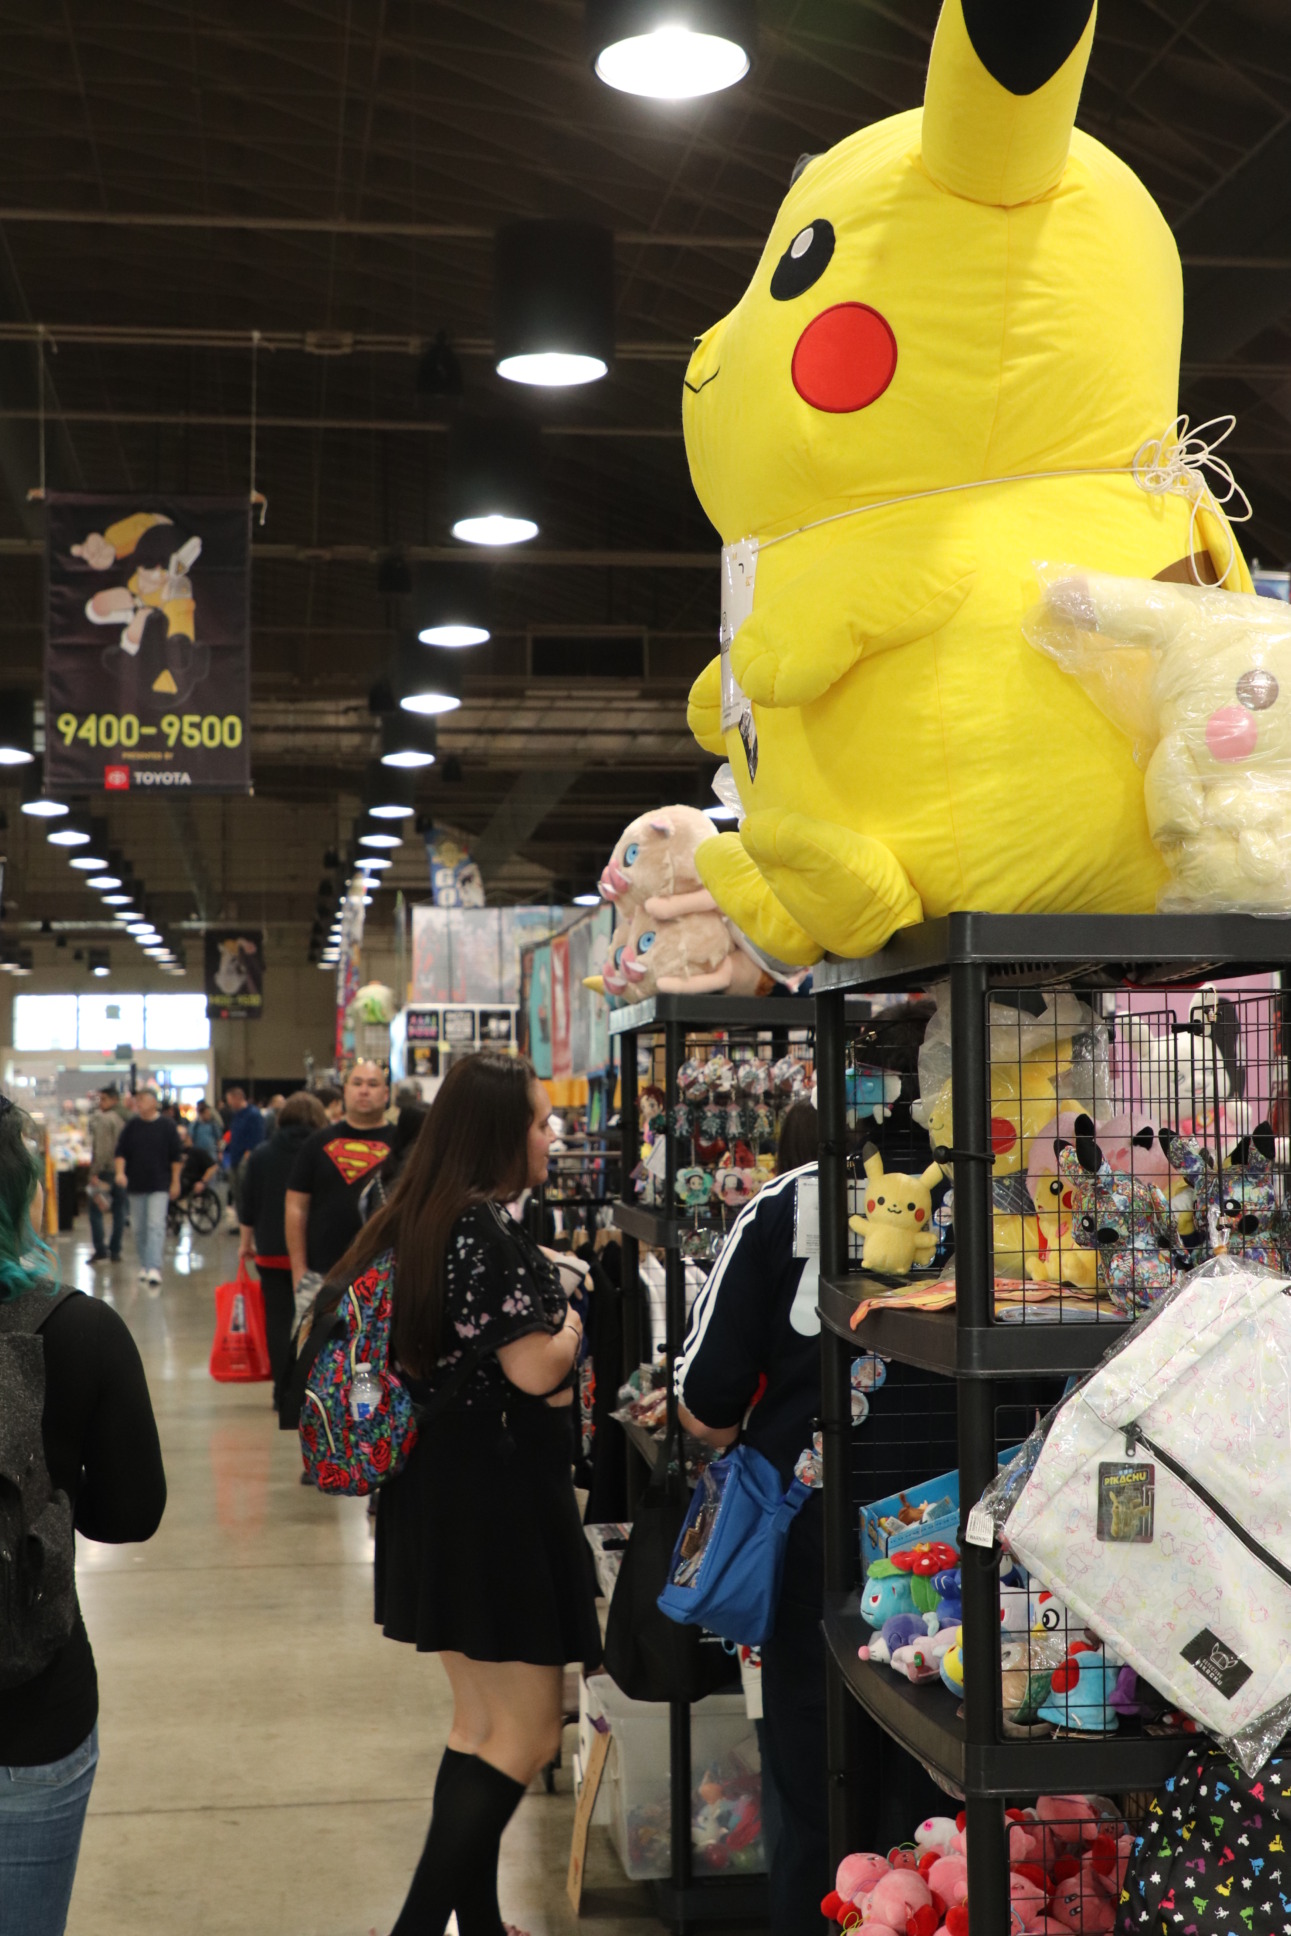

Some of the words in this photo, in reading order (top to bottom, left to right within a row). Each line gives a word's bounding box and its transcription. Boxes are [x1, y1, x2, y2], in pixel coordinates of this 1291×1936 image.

[57, 713, 242, 748] 9400-9500
[134, 771, 192, 786] TOYOTA
[1104, 1471, 1147, 1486] PIKACHU
